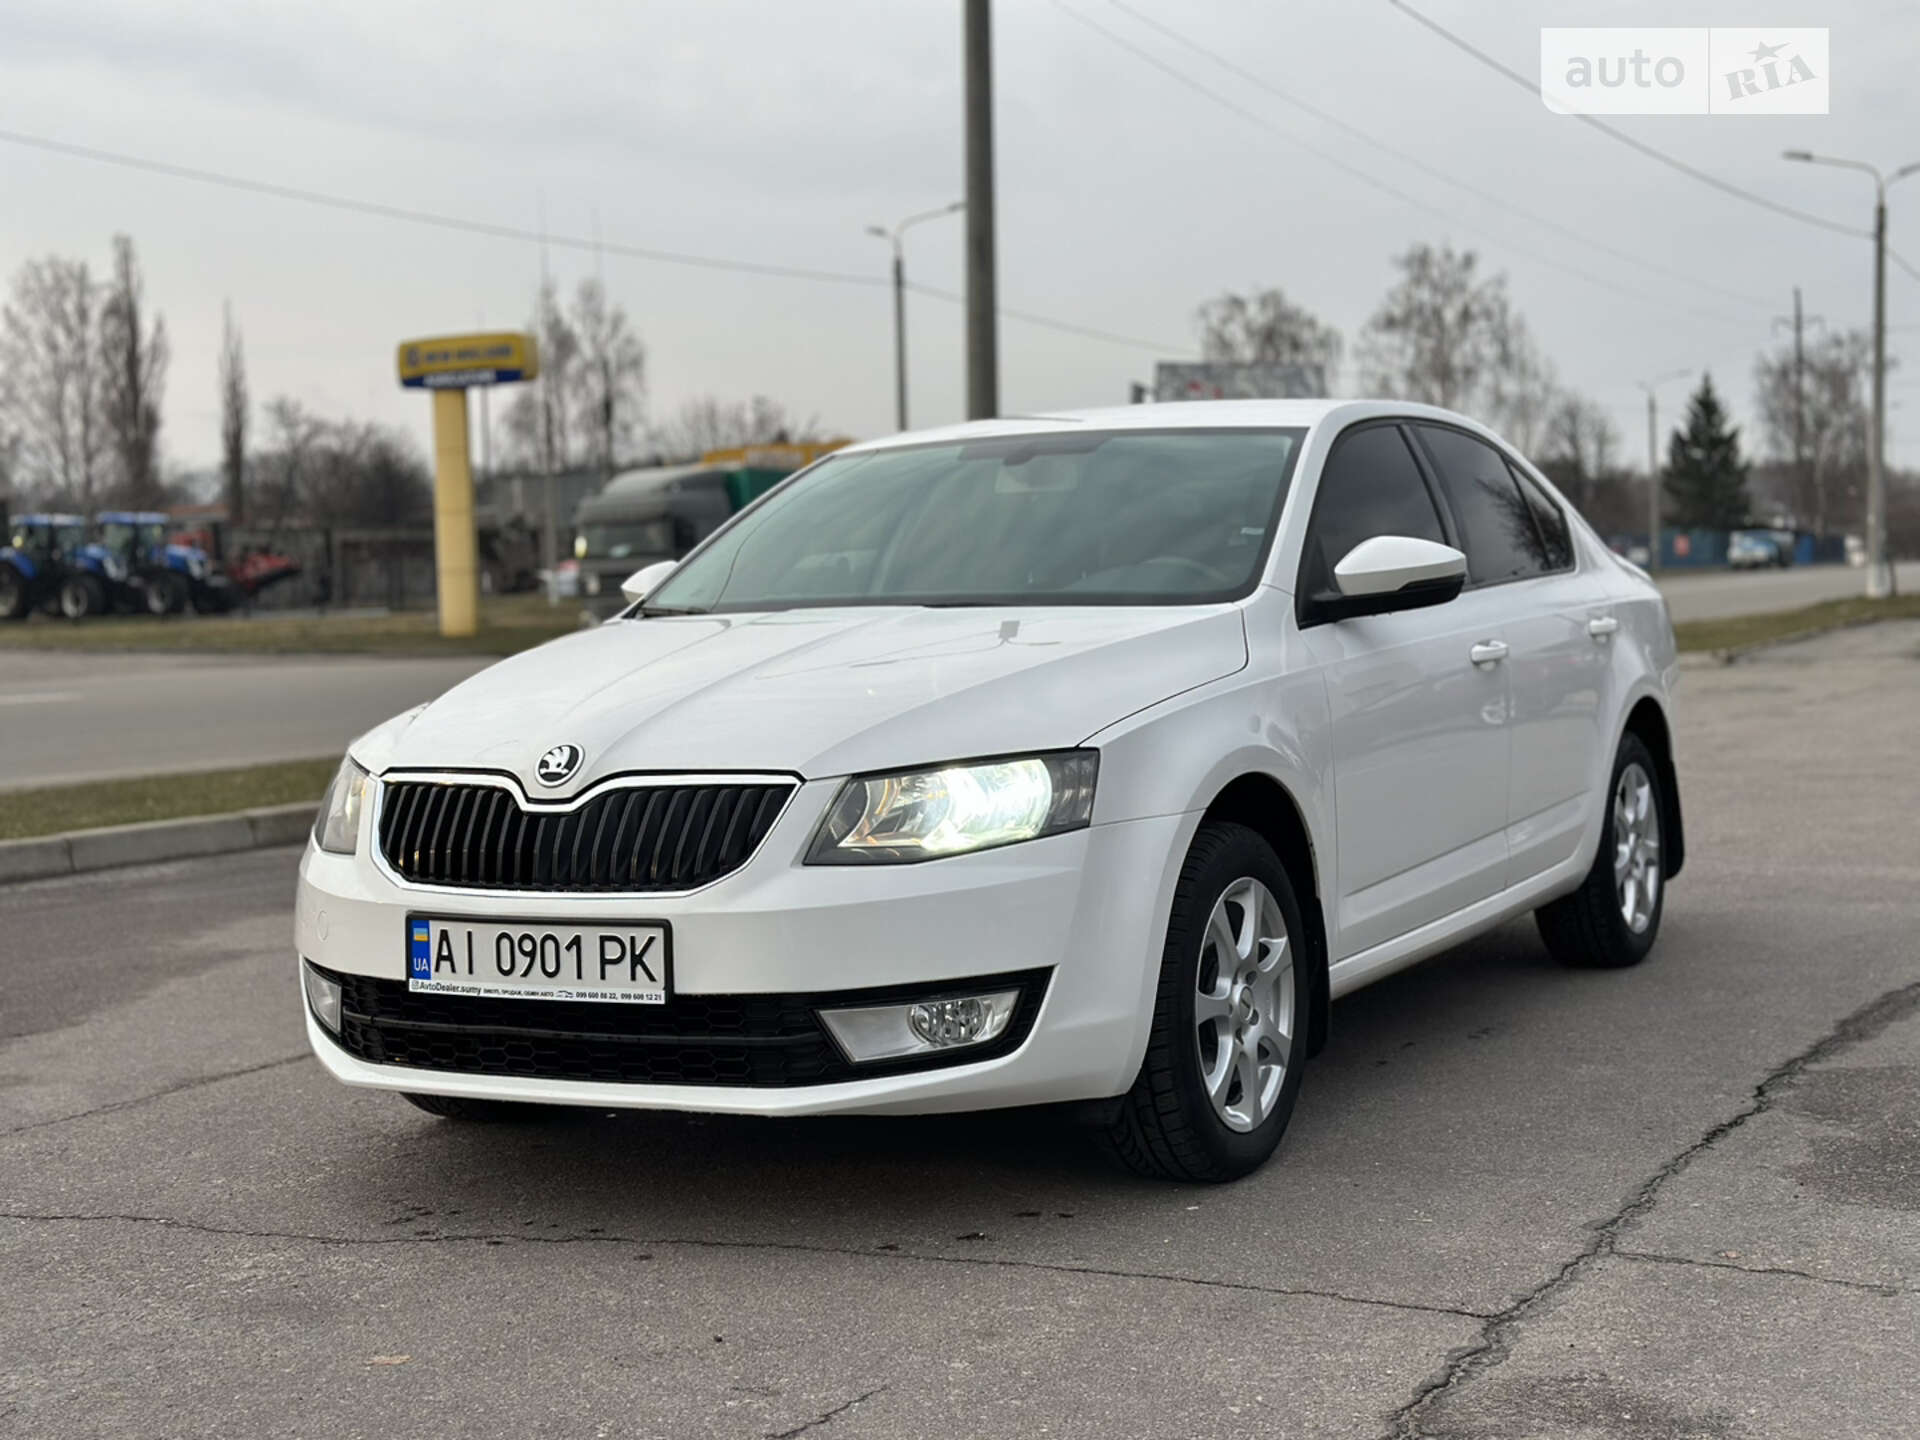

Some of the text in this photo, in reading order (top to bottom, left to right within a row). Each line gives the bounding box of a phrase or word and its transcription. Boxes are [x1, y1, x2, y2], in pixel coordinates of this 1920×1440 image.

[413, 958, 430, 972] UA
[434, 929, 657, 982] AI 0901 PK
